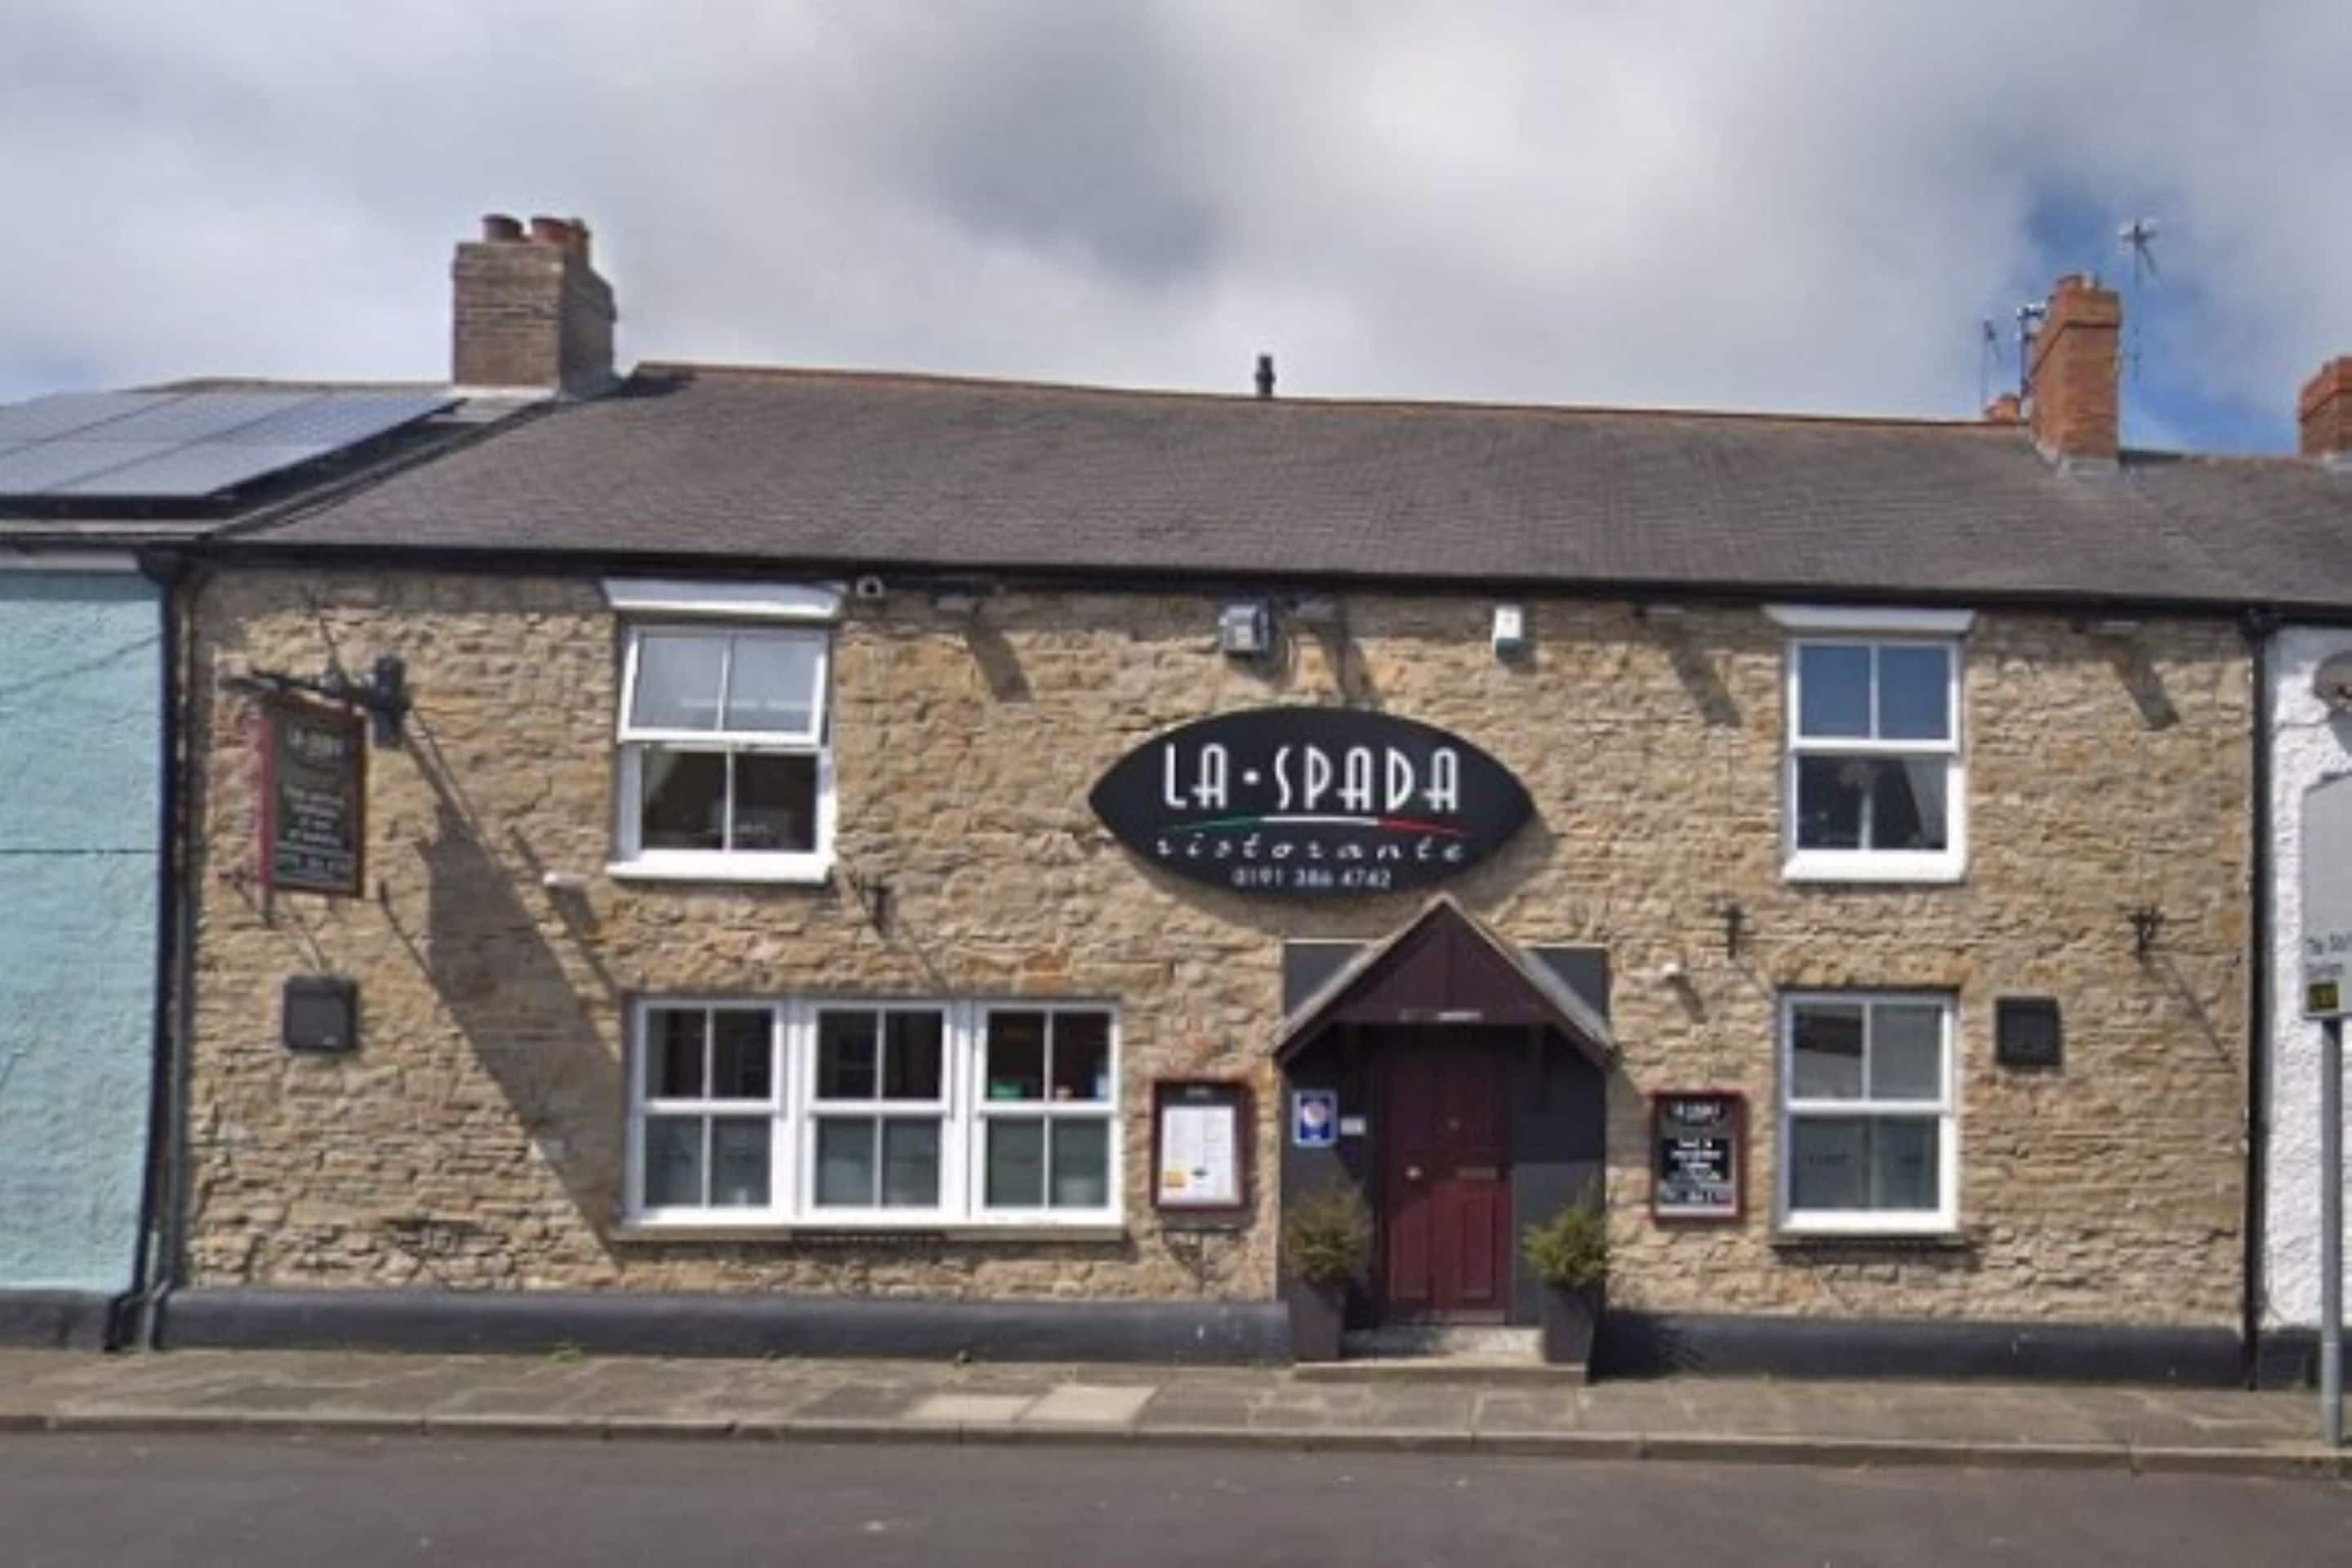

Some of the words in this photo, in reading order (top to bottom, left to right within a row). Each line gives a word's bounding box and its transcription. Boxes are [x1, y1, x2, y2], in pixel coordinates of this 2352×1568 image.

[1164, 742, 1227, 808] LA
[1274, 744, 1459, 811] SPADA
[1156, 832, 1465, 861] ristorante
[1232, 866, 1283, 888] 0191
